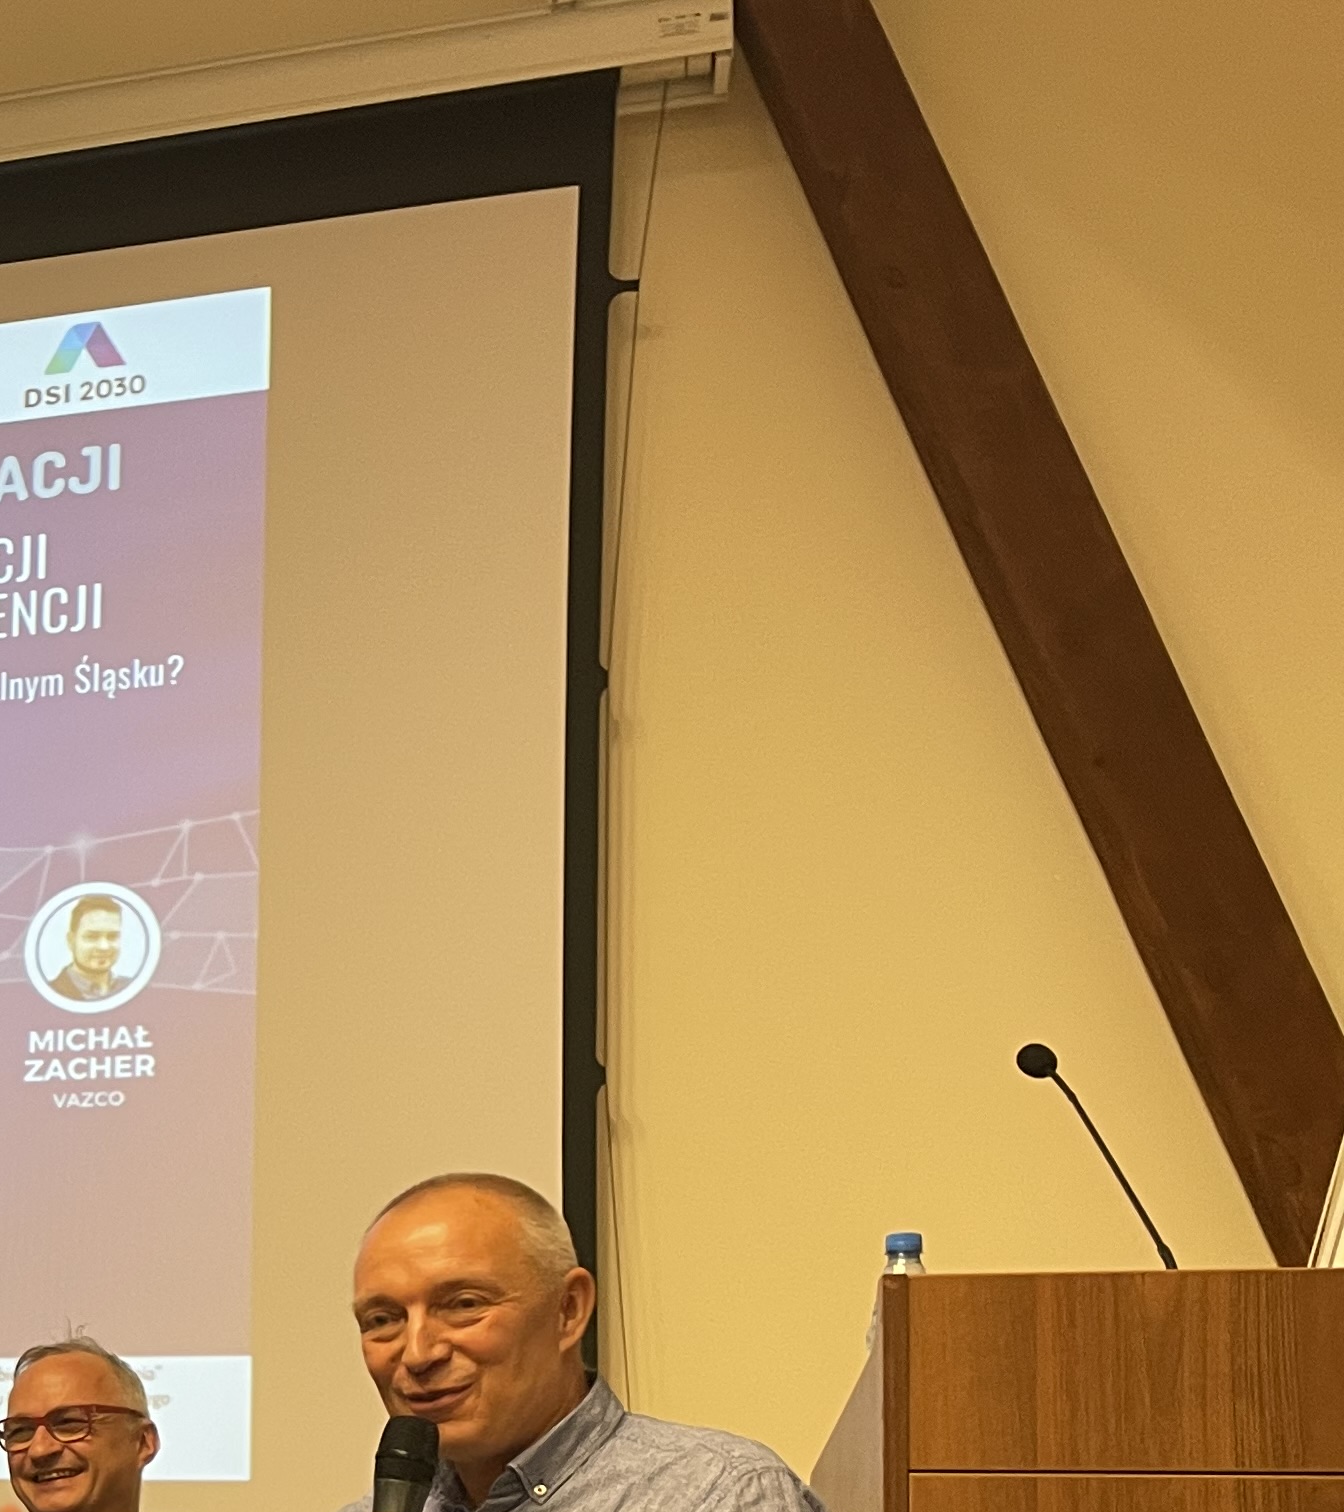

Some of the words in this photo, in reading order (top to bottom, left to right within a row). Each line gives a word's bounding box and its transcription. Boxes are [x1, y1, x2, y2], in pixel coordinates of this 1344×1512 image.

[24, 384, 71, 409] DSI
[80, 374, 146, 401] 2030
[73, 653, 185, 700] Śląsku?
[28, 1025, 153, 1053] MICHAŁ
[23, 1055, 156, 1083] ZACHER
[53, 1091, 125, 1109] VAZCO
